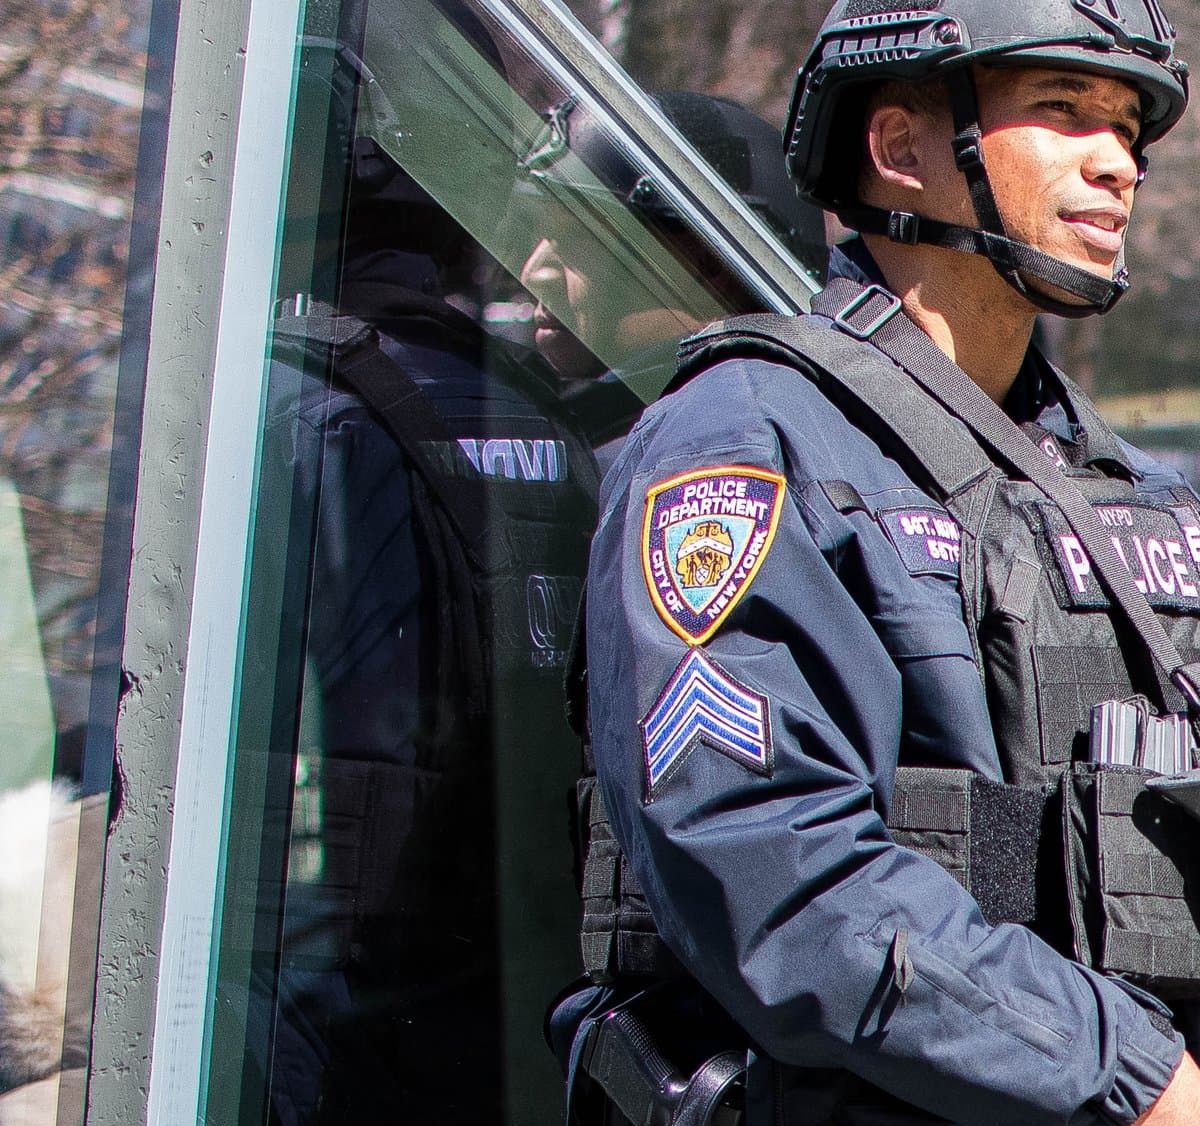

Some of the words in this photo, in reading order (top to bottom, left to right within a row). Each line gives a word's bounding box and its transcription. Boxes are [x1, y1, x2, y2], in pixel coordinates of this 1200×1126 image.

[658, 497, 768, 529] DEPARTMENT
[684, 481, 747, 503] POLICE
[651, 550, 670, 588] CITY
[665, 592, 683, 614] OF
[707, 582, 737, 619] NEW
[734, 530, 768, 584] YORK
[1060, 535, 1199, 597] PLICE
